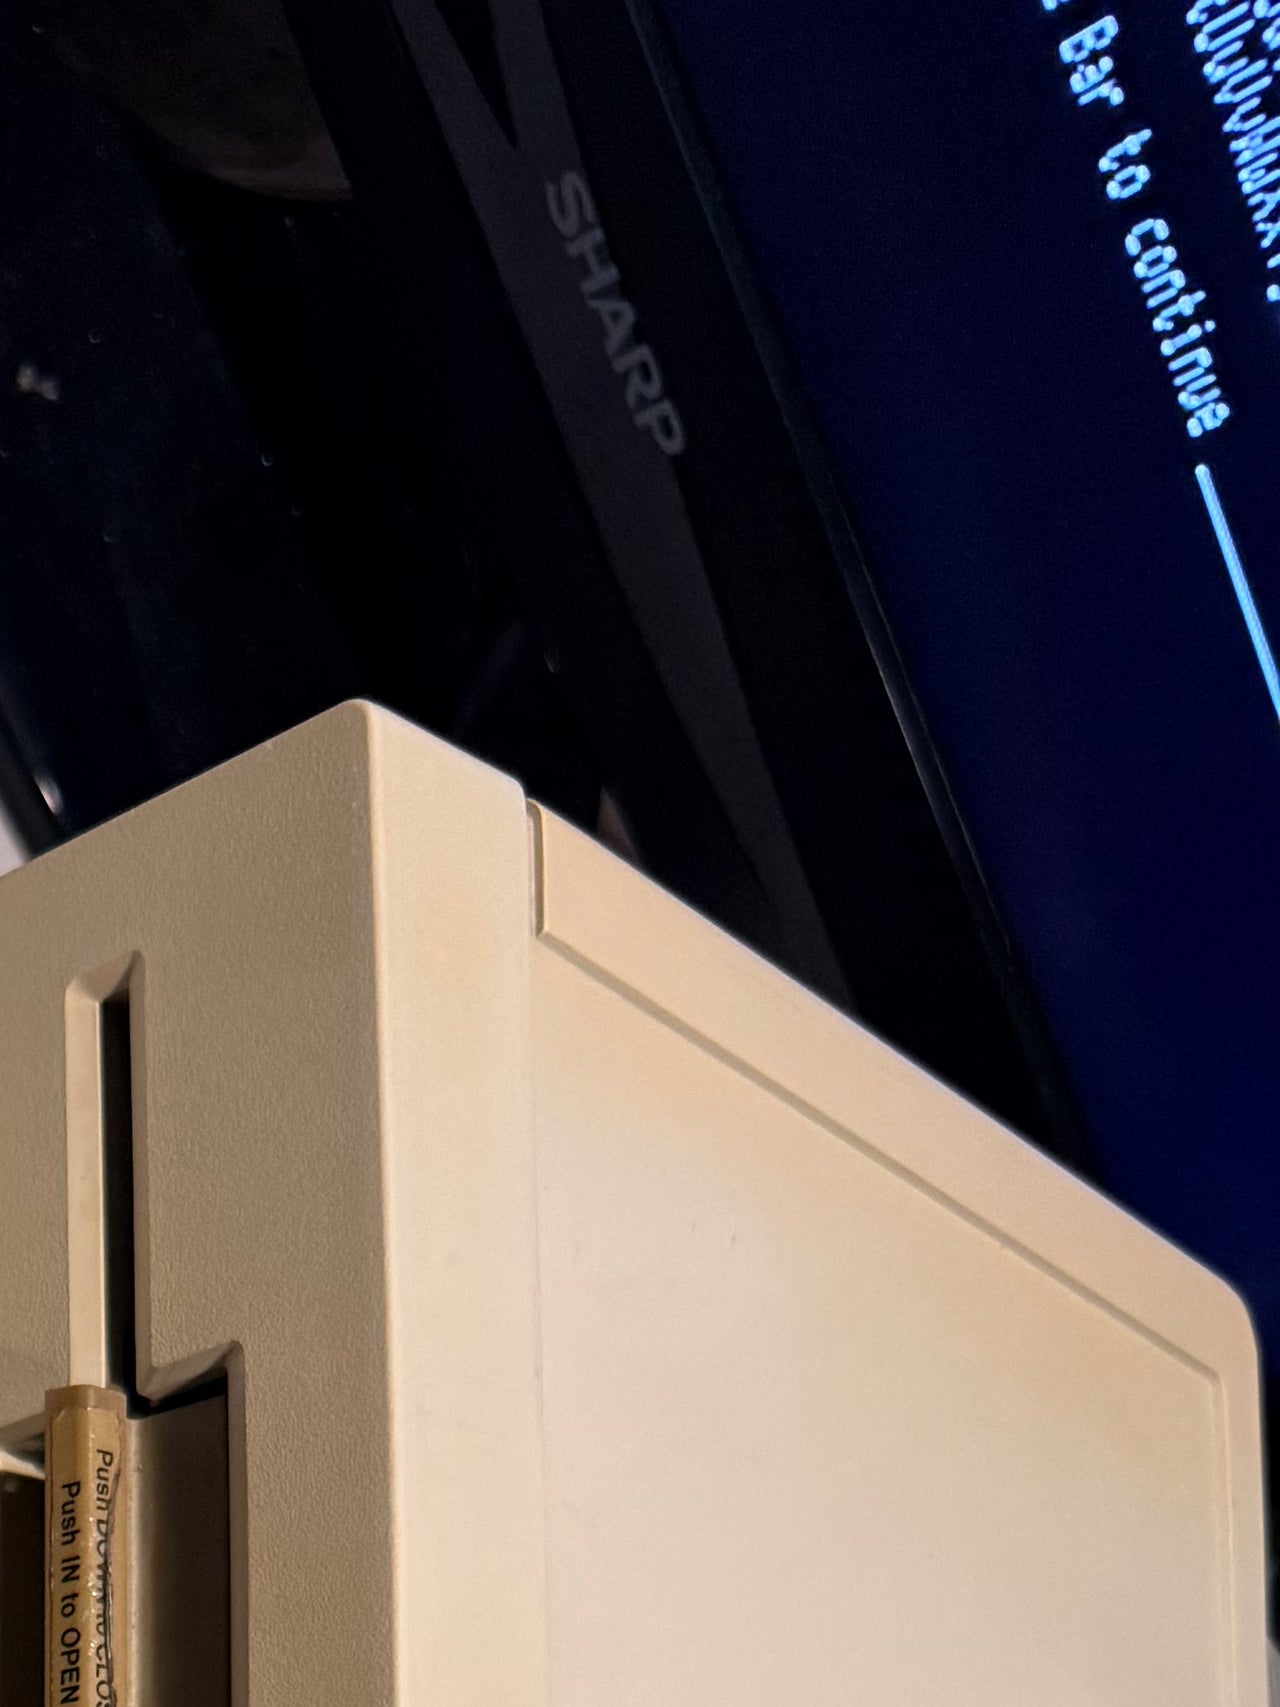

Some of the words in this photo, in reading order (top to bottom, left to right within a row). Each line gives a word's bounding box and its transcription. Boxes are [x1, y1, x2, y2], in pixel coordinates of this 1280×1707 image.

[1059, 15, 1123, 106] Bar
[1099, 129, 1152, 198] to
[546, 170, 686, 455] SHARP
[1125, 219, 1230, 436] continue
[59, 1482, 81, 1545] Push
[96, 1449, 114, 1511] Push
[60, 1556, 80, 1583] IN
[60, 1594, 79, 1617] to
[59, 1628, 80, 1704] OPEN
